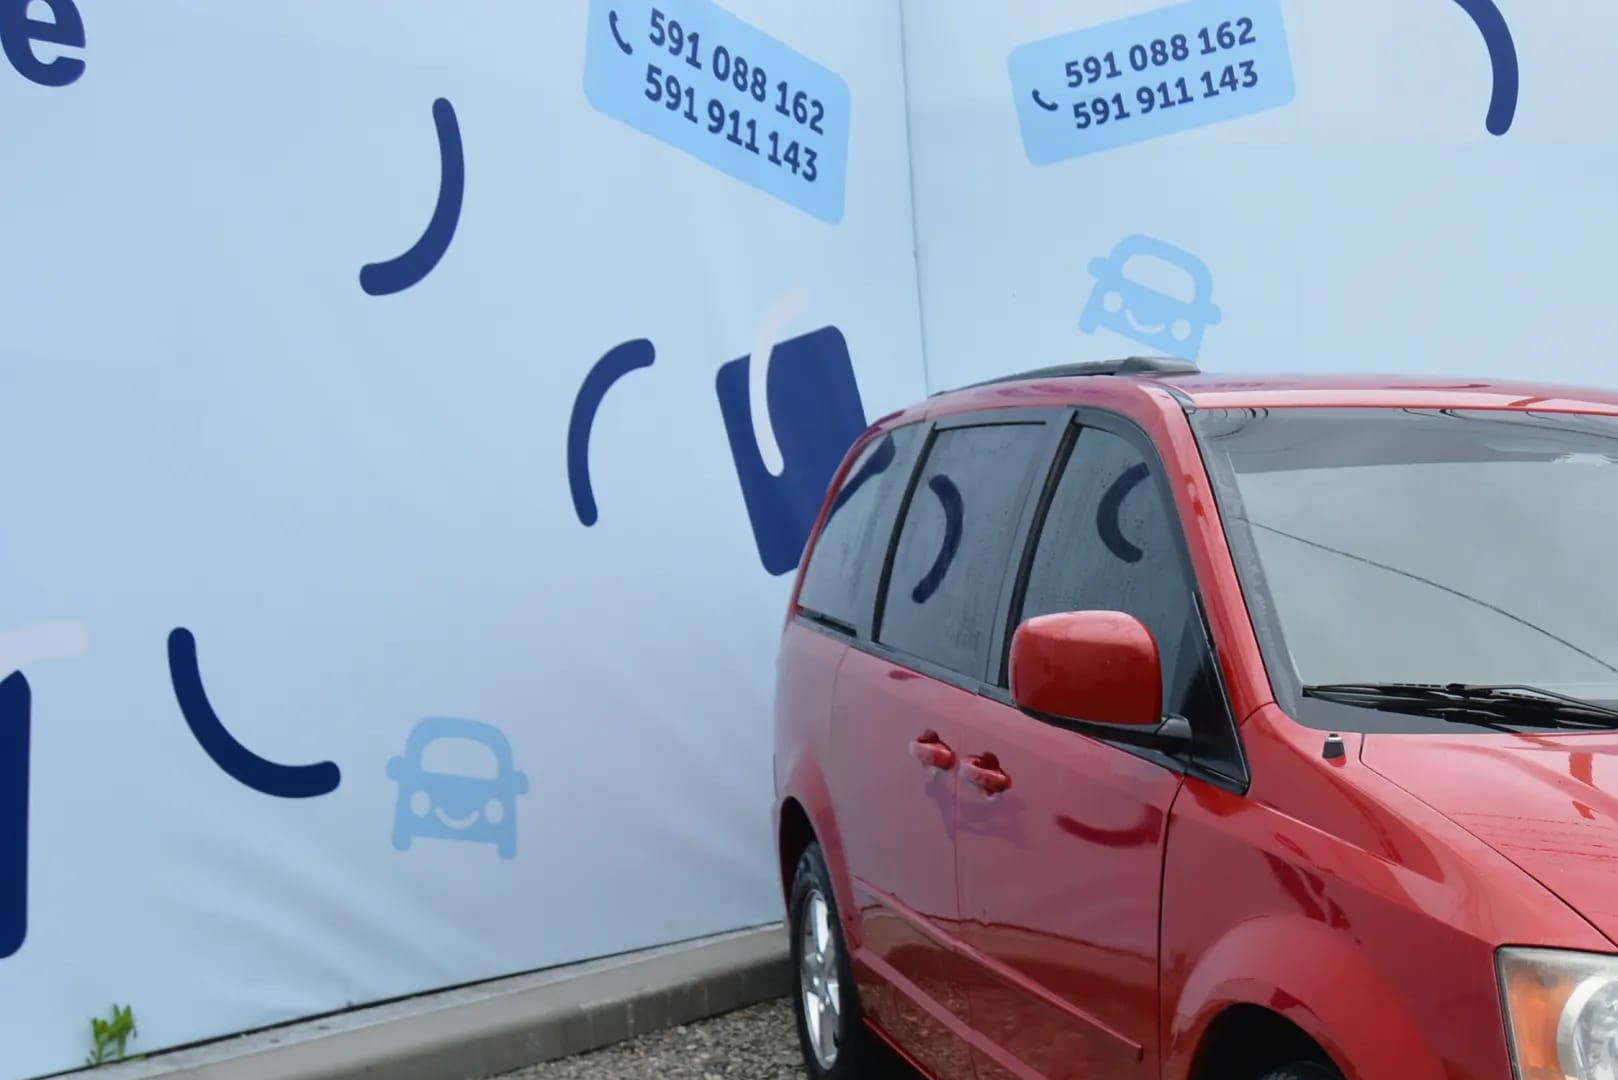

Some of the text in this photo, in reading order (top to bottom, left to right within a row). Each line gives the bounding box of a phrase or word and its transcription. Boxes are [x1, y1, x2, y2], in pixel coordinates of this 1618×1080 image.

[649, 7, 825, 136] 591 088 162
[1064, 16, 1257, 89] 591 088 162
[1072, 59, 1258, 130] 591 911 143
[644, 63, 818, 183] 591 911 143
